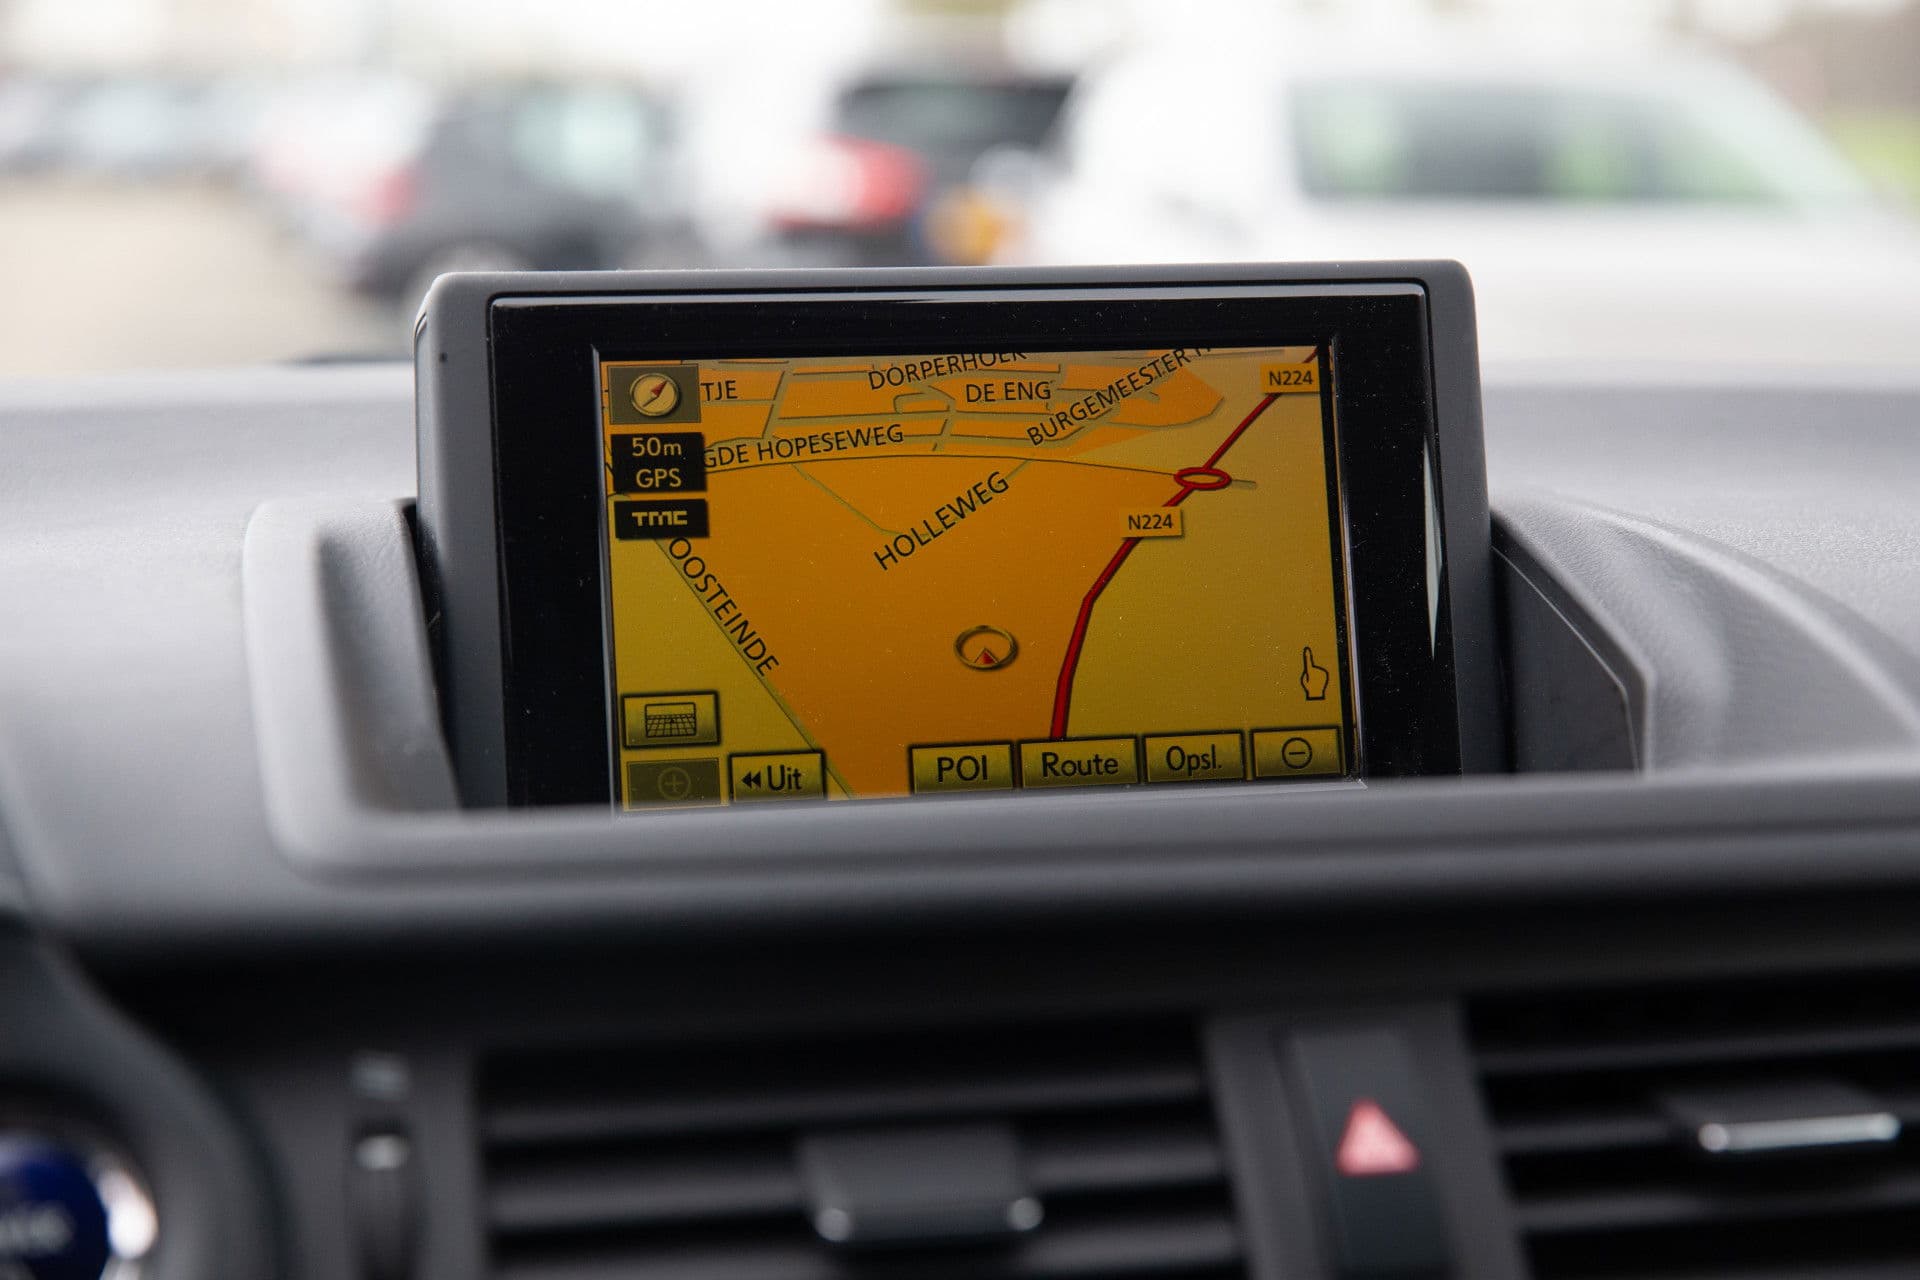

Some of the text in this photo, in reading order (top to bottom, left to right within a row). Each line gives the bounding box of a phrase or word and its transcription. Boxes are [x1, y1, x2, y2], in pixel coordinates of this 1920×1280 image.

[700, 380, 738, 402] TJE
[1268, 370, 1313, 386] N224
[966, 381, 1051, 403] DE ENG
[1027, 349, 1191, 446] BURGEMEESTER
[631, 437, 682, 457] 50m
[757, 424, 904, 462] HOPESEWEG
[636, 469, 682, 488] GPS
[631, 511, 688, 527] TMC
[873, 470, 1010, 571] HOLLEWEG
[1128, 514, 1173, 531] N224
[668, 537, 779, 677] OOSTEINDE
[937, 755, 988, 784] POI
[1041, 751, 1118, 778] Route
[1165, 744, 1223, 775] Opsl.
[766, 764, 803, 791] Uit
